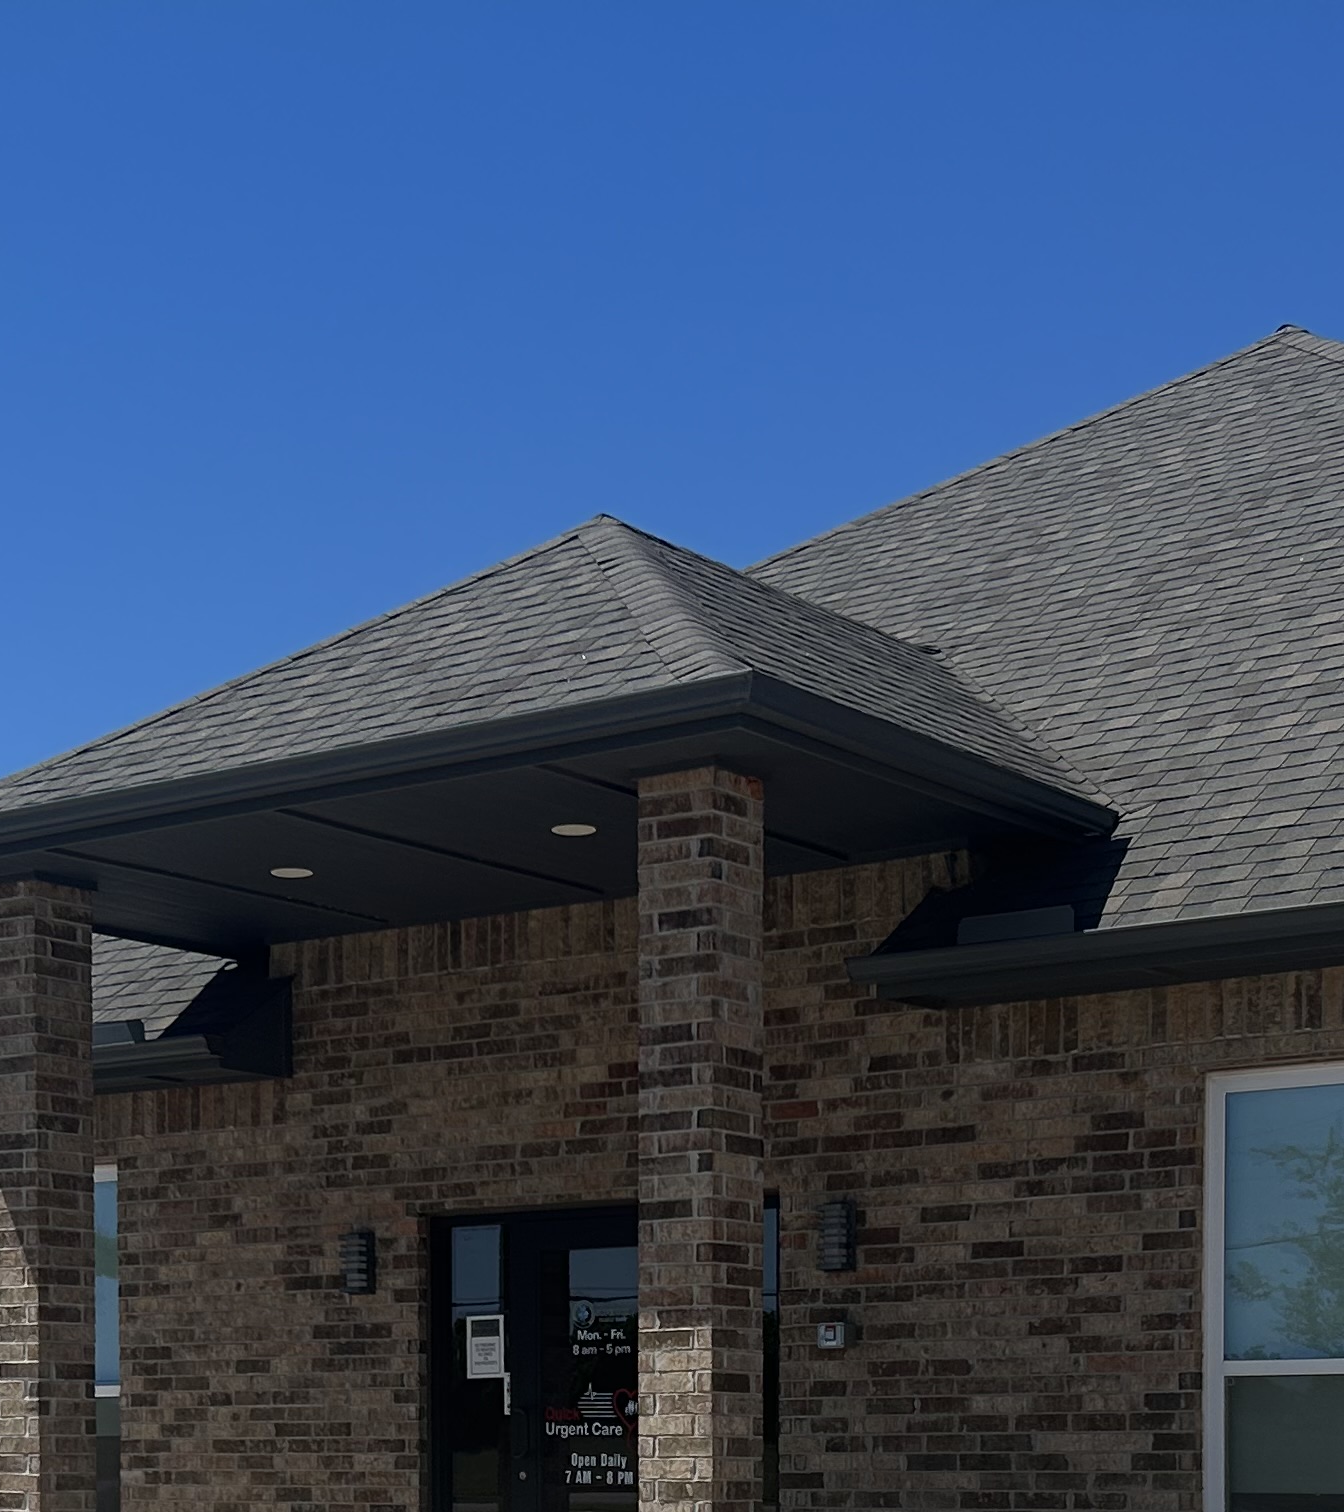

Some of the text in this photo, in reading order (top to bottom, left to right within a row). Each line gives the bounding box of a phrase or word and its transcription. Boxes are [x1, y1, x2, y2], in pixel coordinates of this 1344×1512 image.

[577, 1330, 602, 1340] Mon.
[573, 1345, 579, 1355] 8
[581, 1346, 598, 1355] am
[605, 1343, 613, 1355] 5
[615, 1346, 631, 1356] pm
[545, 1422, 623, 1438] Urgent Care
[571, 1452, 628, 1470] Open Daily
[565, 1471, 572, 1484] 7
[575, 1470, 592, 1484] AM
[606, 1471, 613, 1484] 8
[617, 1471, 634, 1485] PM
